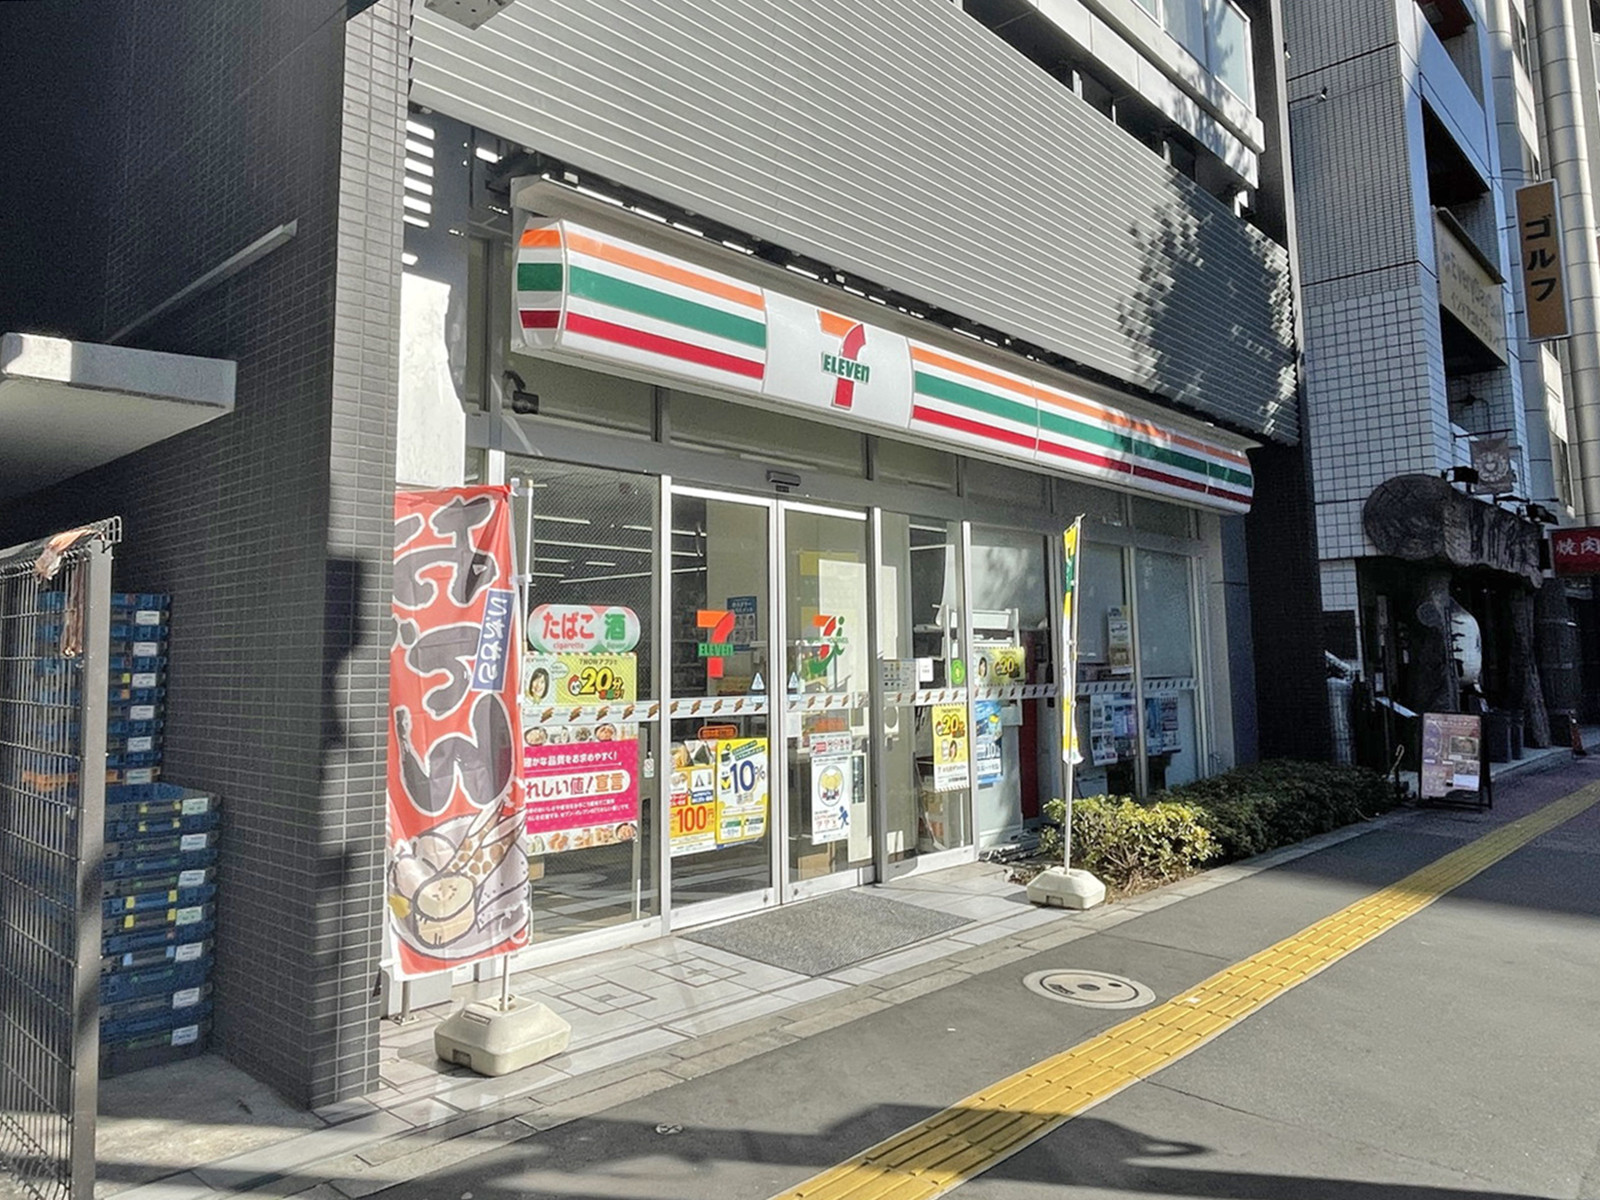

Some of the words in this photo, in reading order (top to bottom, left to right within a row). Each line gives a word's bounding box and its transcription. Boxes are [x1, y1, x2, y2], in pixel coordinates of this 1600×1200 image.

[1525, 214, 1557, 302] ゴルフ
[1556, 536, 1600, 556] 焼肉
[542, 611, 596, 640] たばこ
[604, 613, 627, 640] 酒
